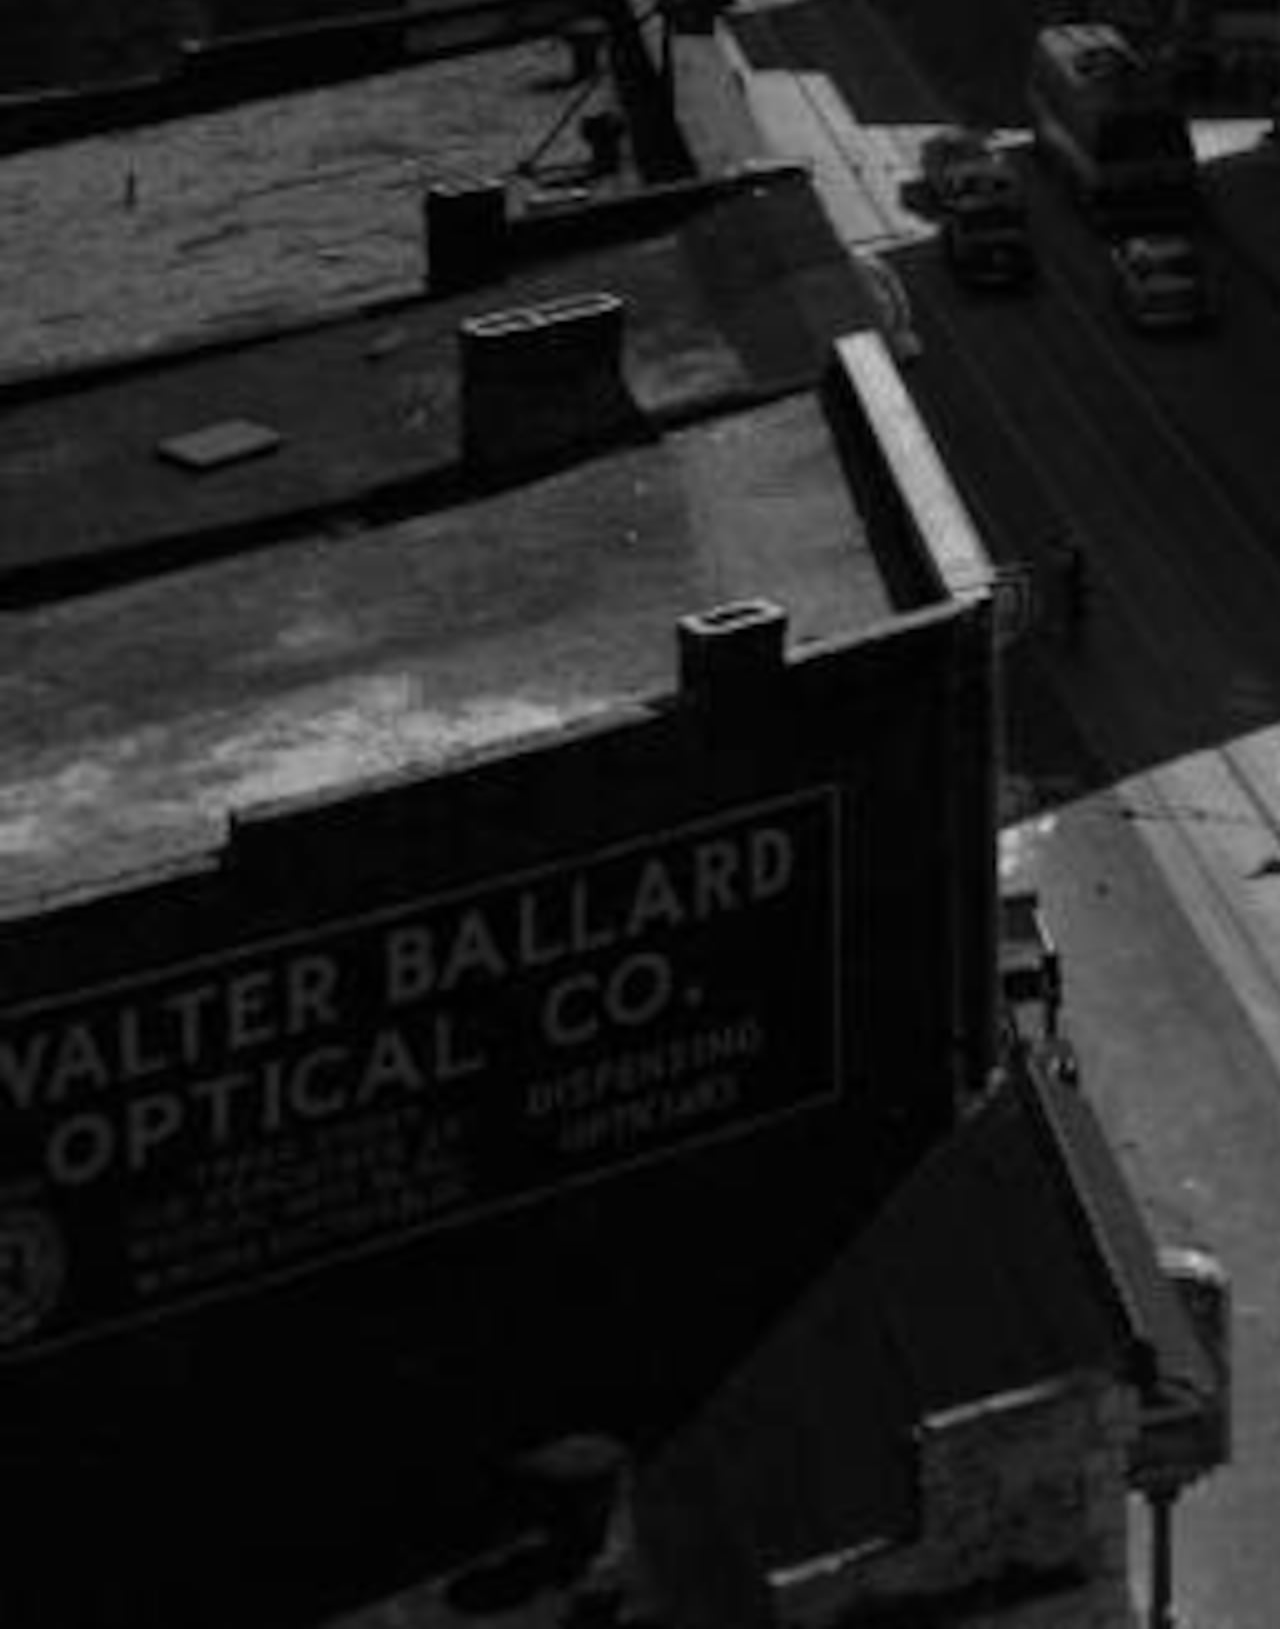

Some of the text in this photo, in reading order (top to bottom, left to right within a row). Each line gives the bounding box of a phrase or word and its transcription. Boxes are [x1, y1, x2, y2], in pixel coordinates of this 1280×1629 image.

[387, 828, 793, 1005] BALLARD
[46, 952, 702, 1185] OPTICAL CO.
